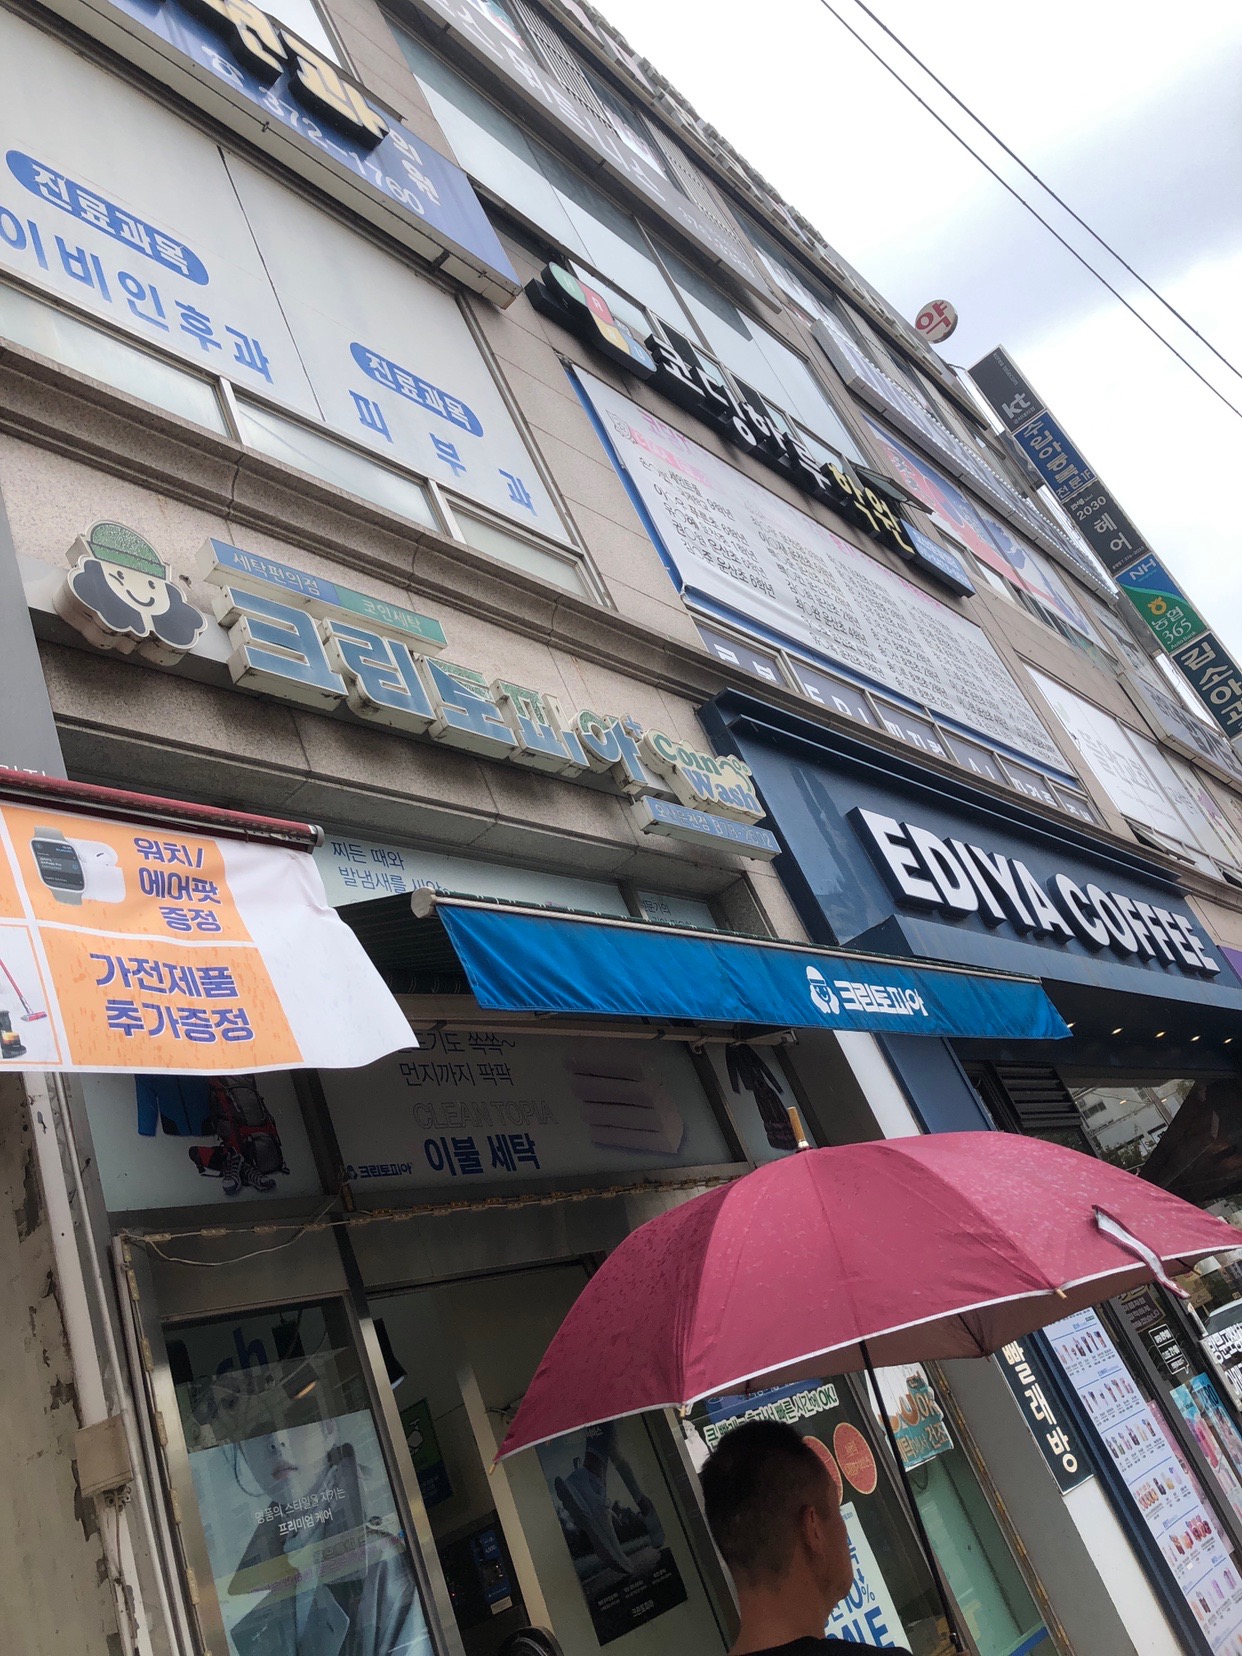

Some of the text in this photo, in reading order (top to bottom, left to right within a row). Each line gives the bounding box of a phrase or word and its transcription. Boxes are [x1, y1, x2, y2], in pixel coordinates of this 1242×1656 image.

[33, 160, 191, 273] 진료과목
[0, 206, 275, 385] 이비인후과
[914, 301, 953, 336] 약
[365, 350, 473, 430] 진료과목
[1001, 391, 1031, 419] kt
[1076, 495, 1107, 521] 2030
[232, 551, 320, 595] 세탁편의점
[1129, 557, 1157, 582] NH
[363, 601, 423, 633] 코인세탁
[1151, 605, 1185, 632] 농협
[1161, 618, 1193, 646] 365
[226, 586, 650, 789] 크린토피아
[653, 732, 722, 777] Coin
[686, 766, 760, 813] Wash
[132, 837, 206, 869] 워치/
[332, 839, 405, 871] 찌든 때와
[138, 867, 222, 906] 에어팟
[338, 866, 407, 893] 발냄새를
[857, 806, 1221, 974] EDIYA COFFEE
[160, 906, 224, 934] 증정
[89, 952, 240, 1000] 가전제품
[837, 980, 929, 1017] 크린토피아
[105, 999, 256, 1044] 추가증정
[398, 1061, 515, 1087] 먼지까지 팍팍
[358, 1161, 412, 1179] 크린토피아
[424, 1132, 542, 1177] 이불 세탁
[819, 1386, 838, 1406] OK!
[1000, 1341, 1079, 1474] 빨래방
[278, 1507, 334, 1537] 프리미엄 케어
